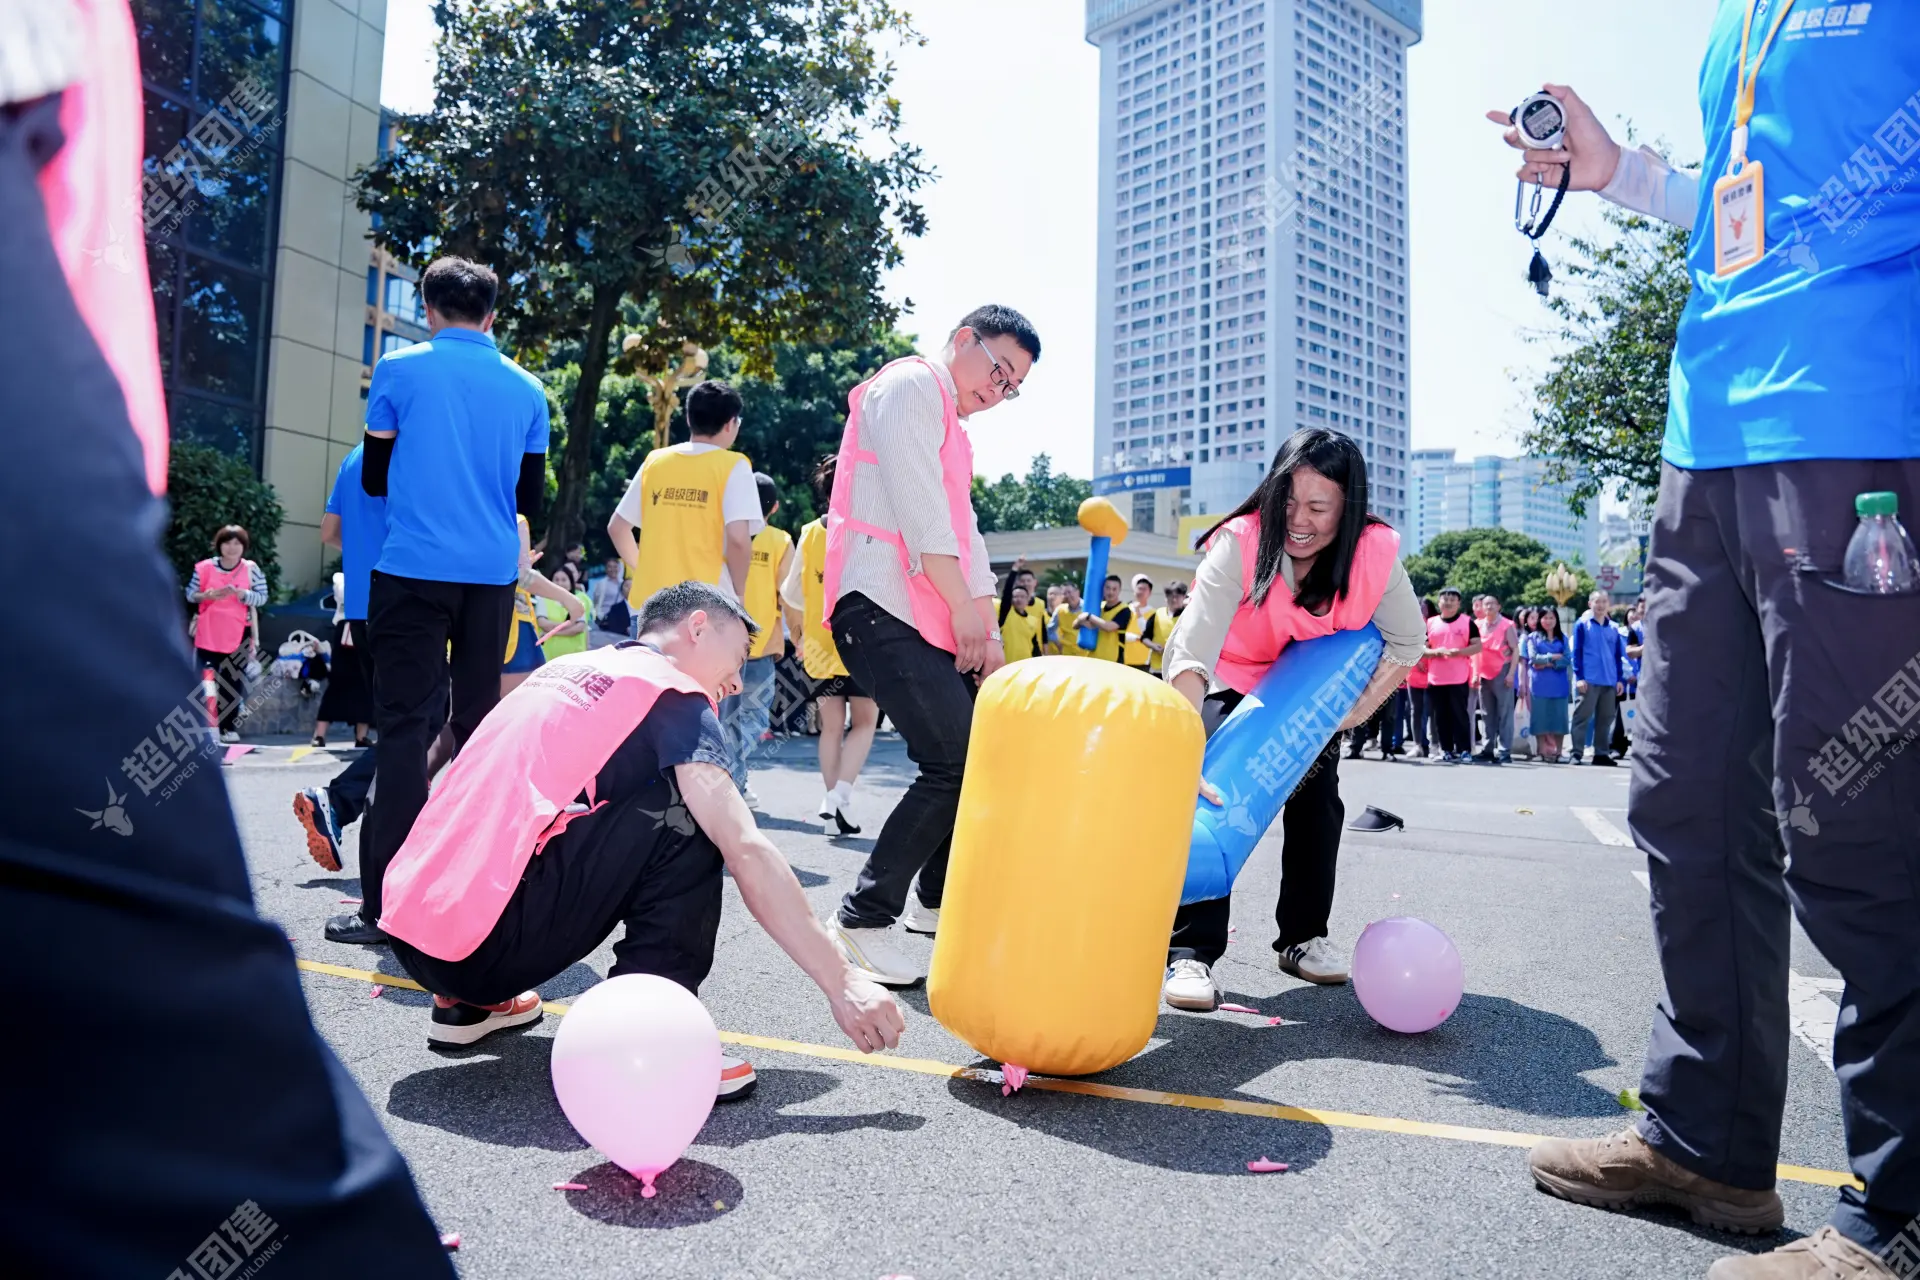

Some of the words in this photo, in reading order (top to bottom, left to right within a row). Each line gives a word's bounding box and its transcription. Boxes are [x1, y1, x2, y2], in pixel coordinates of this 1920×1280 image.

[663, 487, 708, 504] 超级团建
[556, 684, 592, 712] BUILDING
